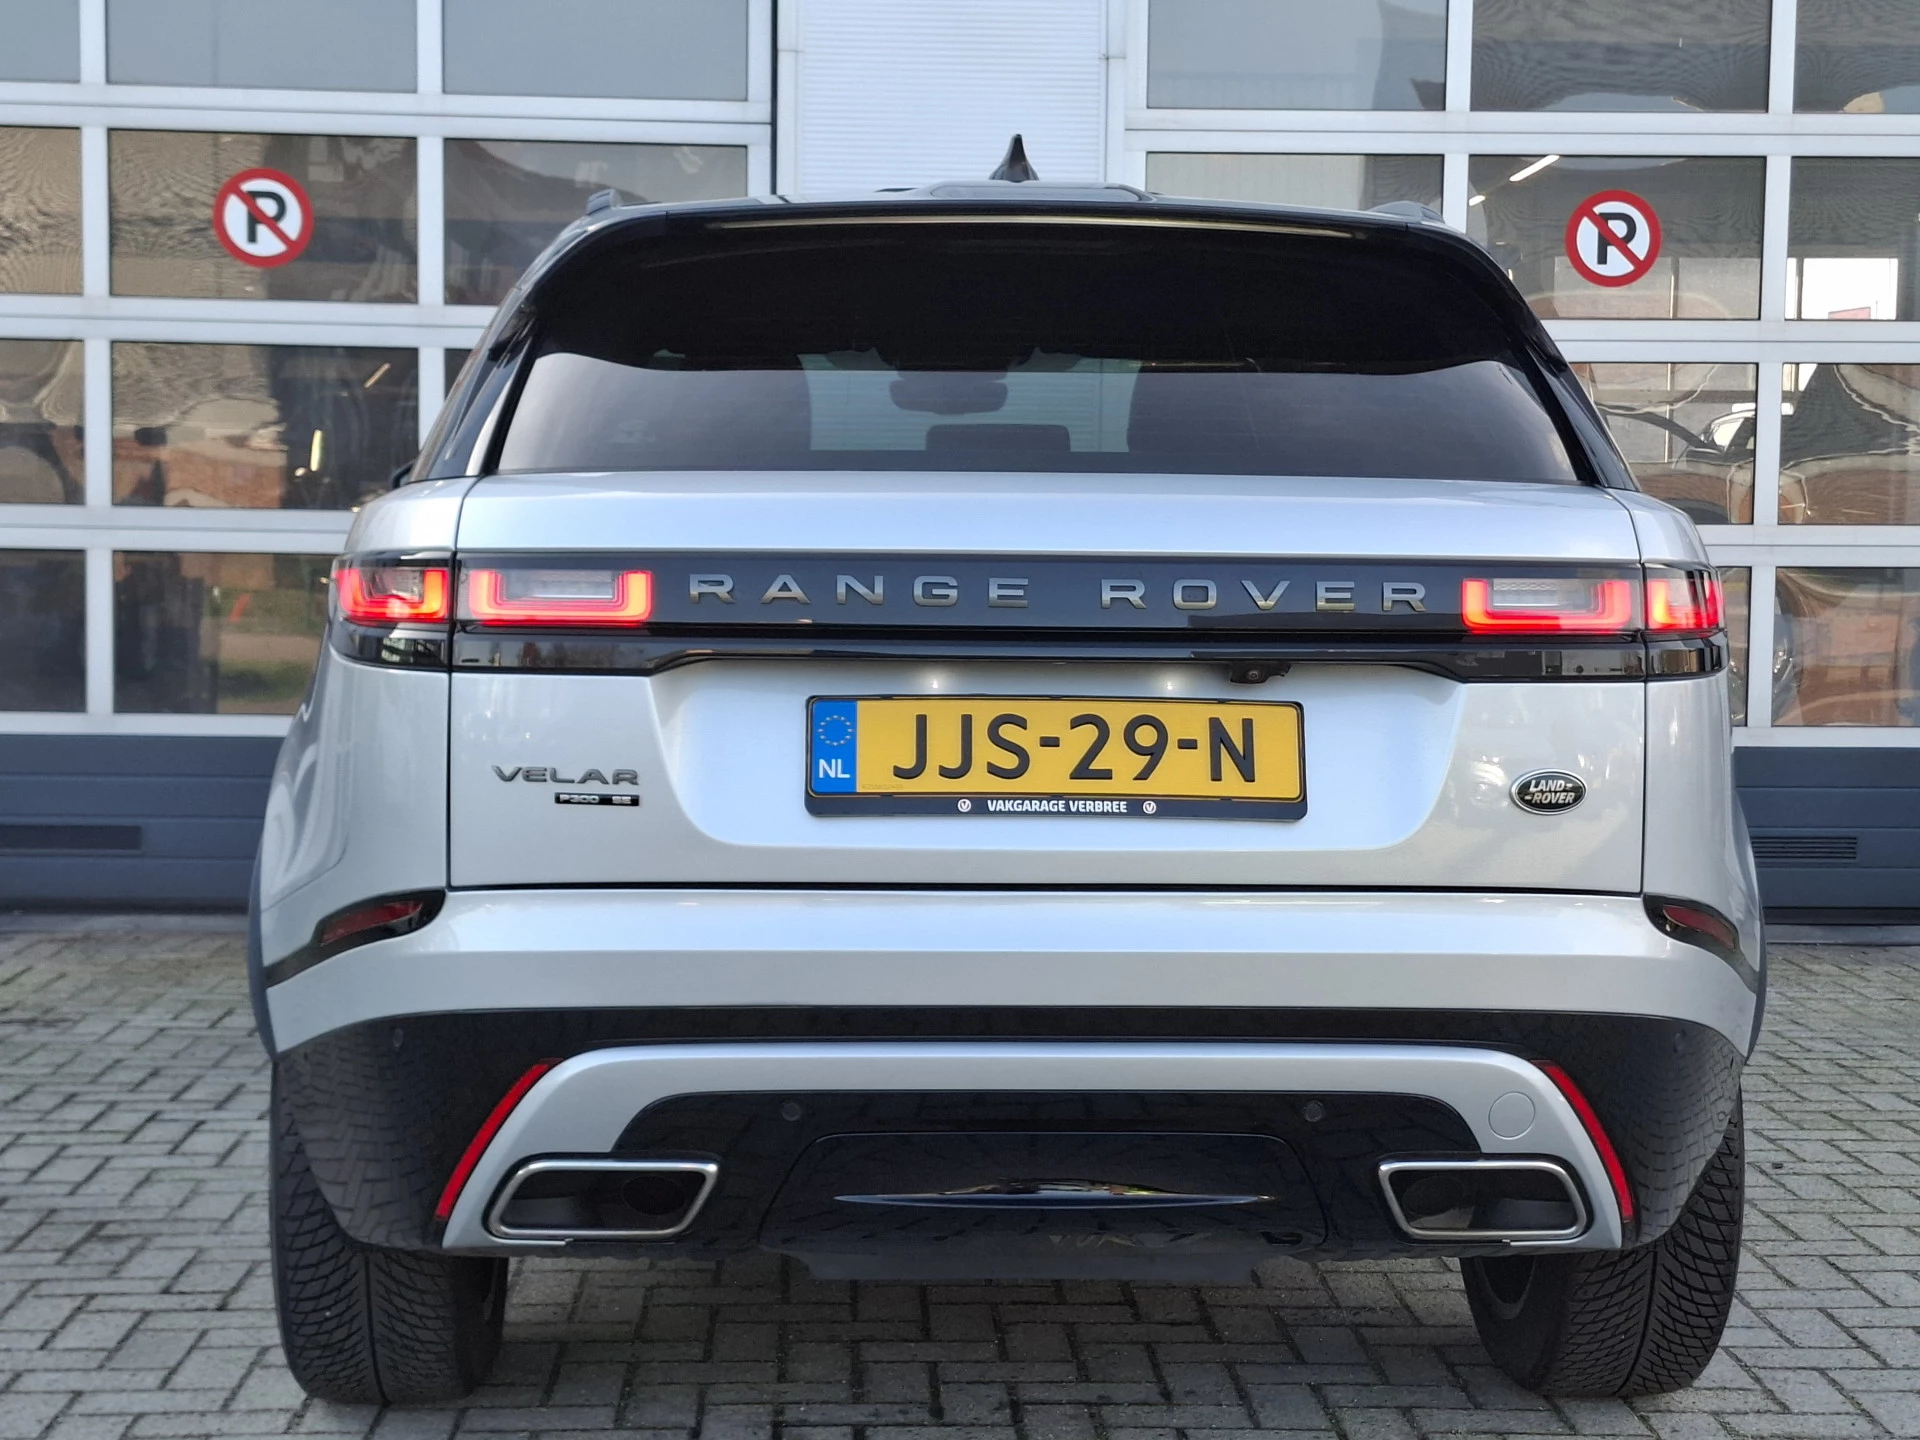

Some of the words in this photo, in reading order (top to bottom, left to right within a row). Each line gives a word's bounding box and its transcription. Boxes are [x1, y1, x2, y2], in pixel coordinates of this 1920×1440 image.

[688, 573, 1030, 608] RANGE
[1100, 578, 1427, 613] ROVER
[892, 713, 1256, 783] JJS-29-N
[491, 764, 640, 786] VELAR
[818, 758, 851, 779] NL
[987, 800, 1066, 812] VAKGARAGE
[1068, 800, 1128, 813] VERBREE
